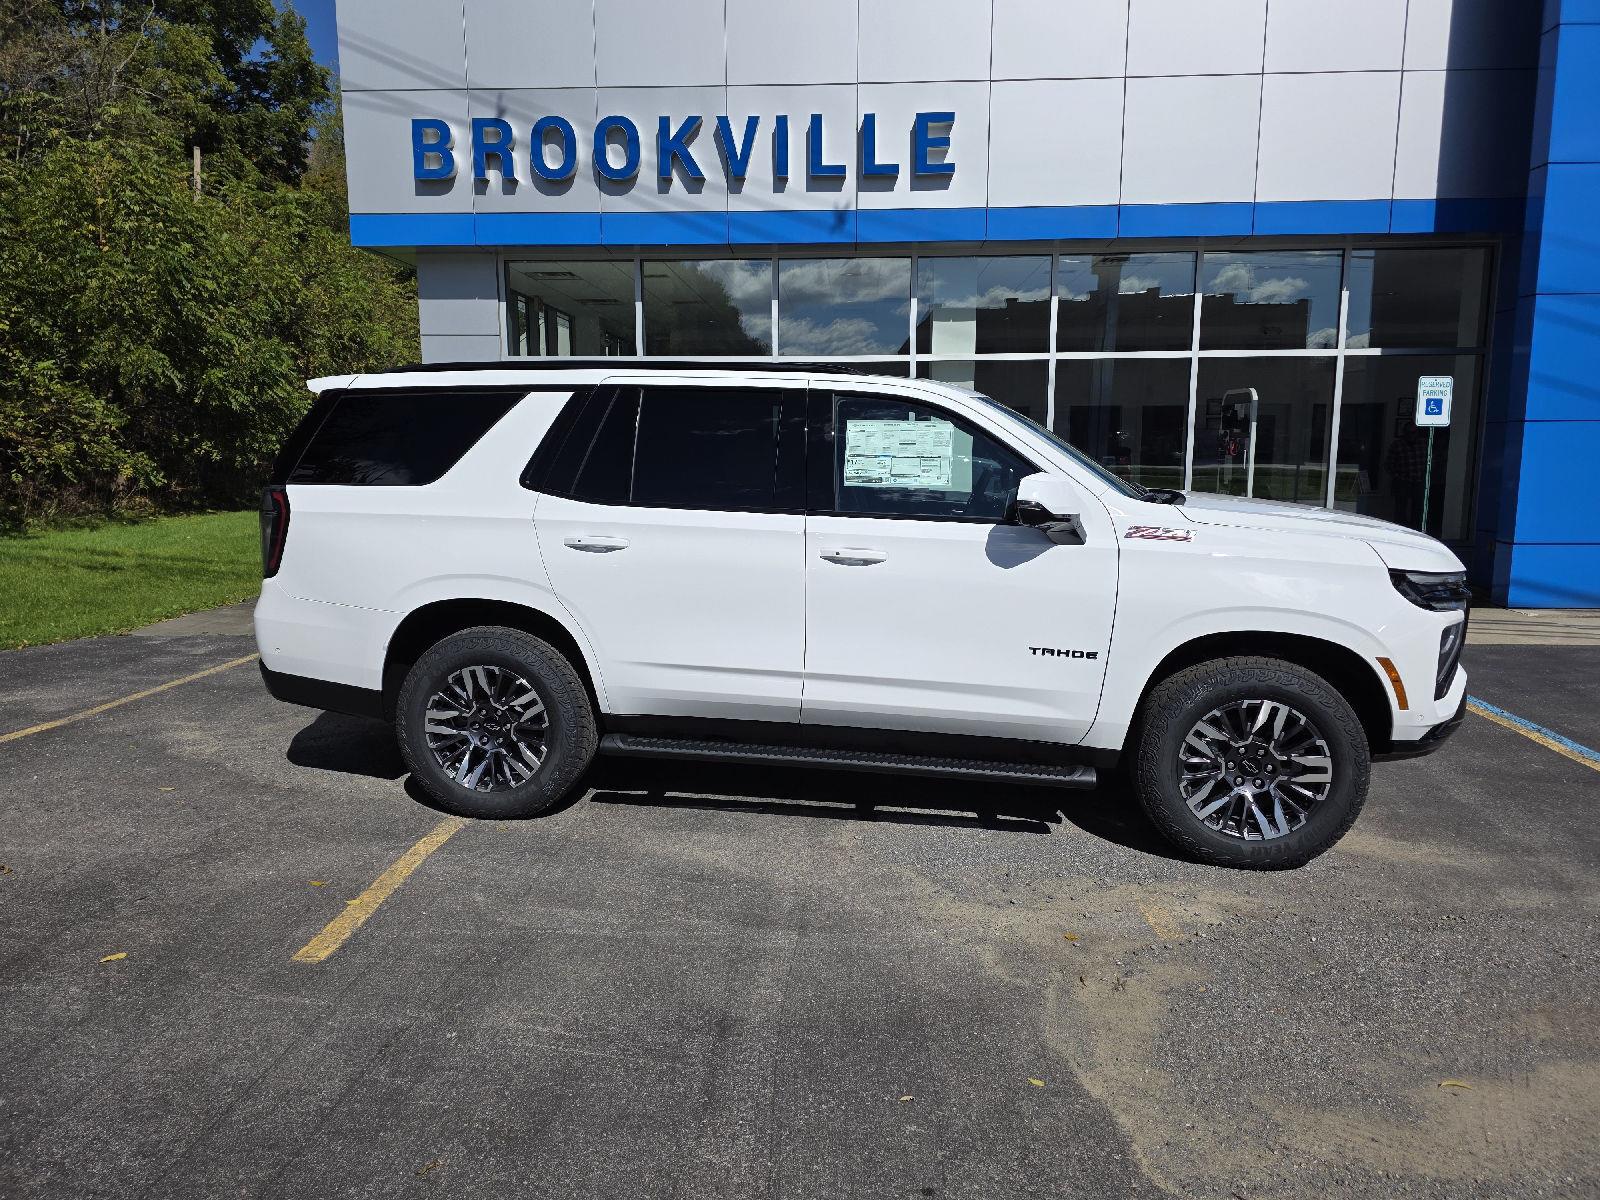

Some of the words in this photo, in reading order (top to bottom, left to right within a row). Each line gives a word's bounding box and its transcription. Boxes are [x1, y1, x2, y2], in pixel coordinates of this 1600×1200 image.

[411, 111, 956, 182] BROOKVILLE
[1422, 389, 1448, 397] PARKING
[1028, 646, 1099, 660] TAHOE
